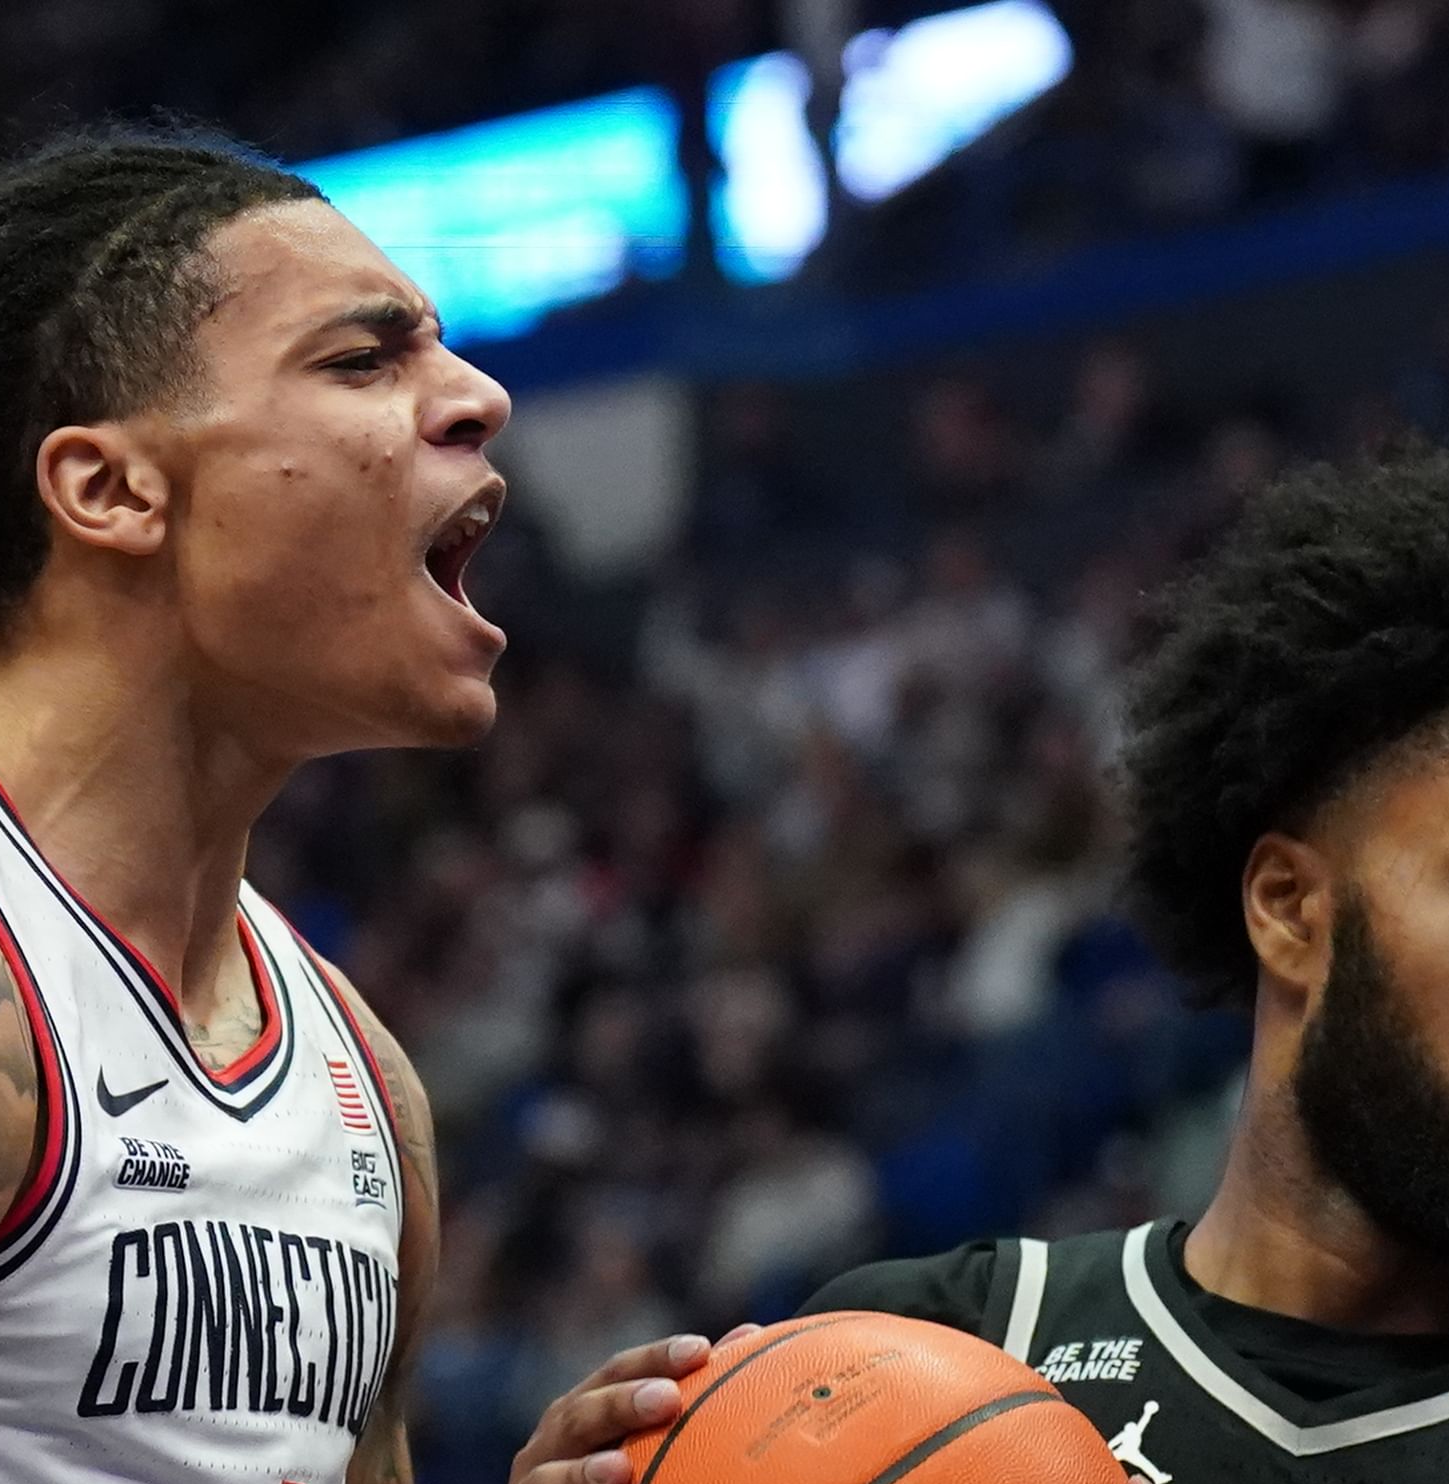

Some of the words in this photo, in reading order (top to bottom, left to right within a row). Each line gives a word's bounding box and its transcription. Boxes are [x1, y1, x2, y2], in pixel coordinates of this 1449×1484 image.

[119, 1136, 149, 1157] BE
[146, 1139, 185, 1161] THE
[351, 1149, 375, 1173] BIG
[117, 1158, 190, 1189] CHANGE
[353, 1174, 387, 1199] EAST
[76, 1220, 398, 1436] CONNECTICU
[1043, 1342, 1085, 1366] BE
[1088, 1339, 1143, 1361] THE
[1035, 1359, 1141, 1383] CHANGE
